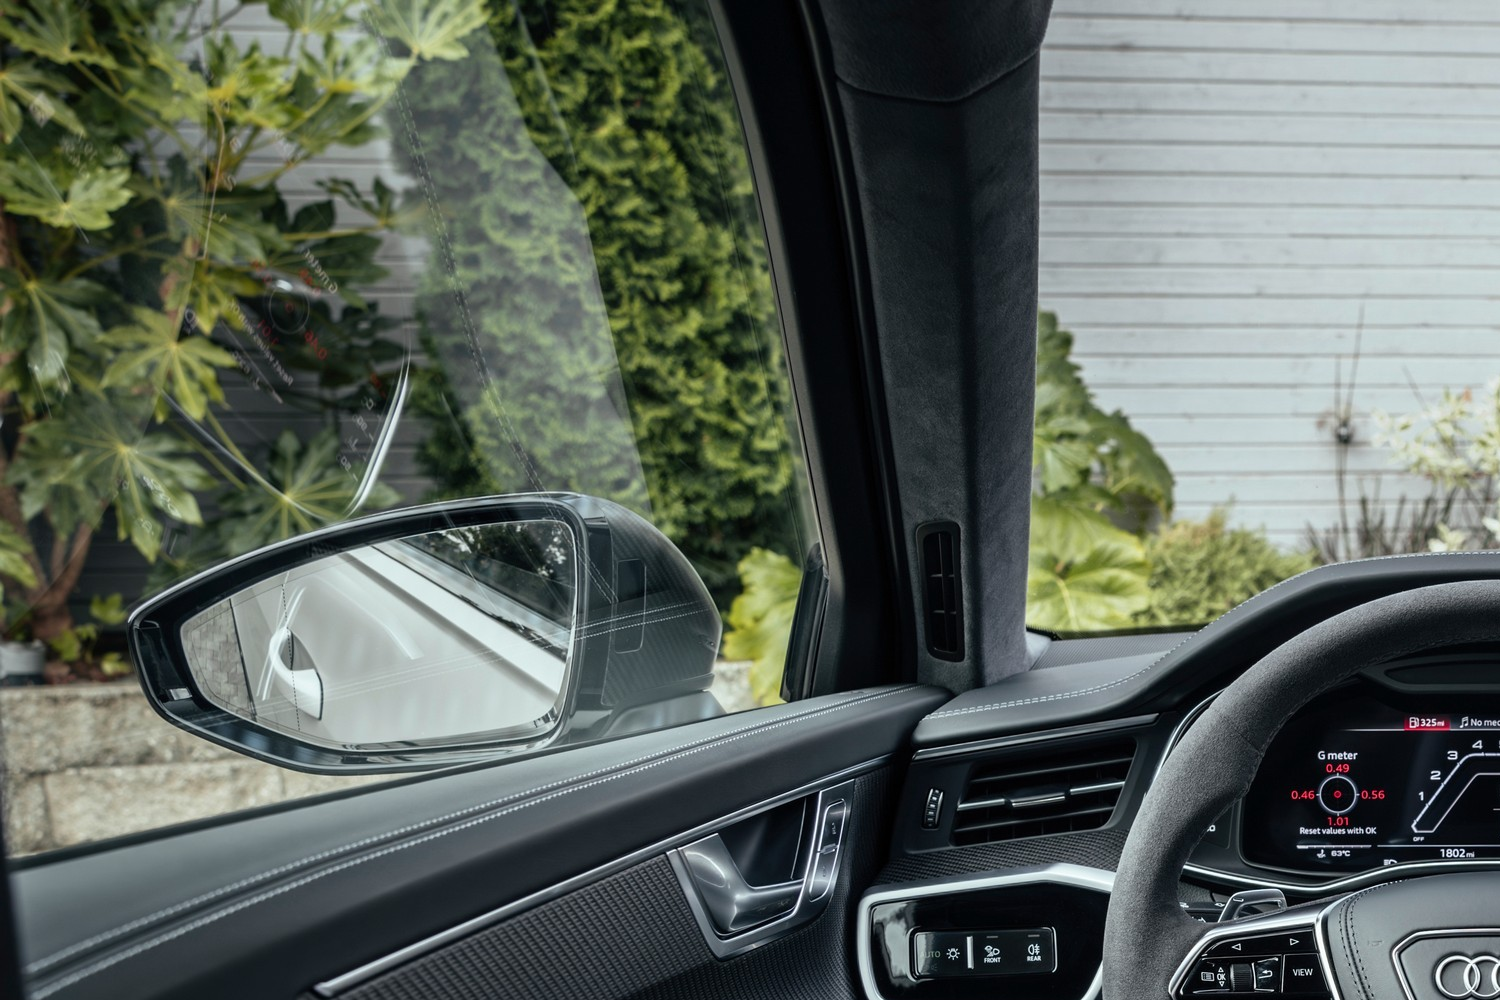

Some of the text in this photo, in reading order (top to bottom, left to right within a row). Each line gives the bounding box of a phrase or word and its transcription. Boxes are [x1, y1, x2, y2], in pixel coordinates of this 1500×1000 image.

[1471, 717, 1482, 726] No
[1472, 740, 1482, 749] 4
[1318, 751, 1358, 760] G meter
[1447, 751, 1458, 760] 3
[1326, 763, 1350, 773] 0.49
[1430, 770, 1441, 780] 2
[1291, 790, 1315, 800] 0.46
[1361, 790, 1385, 800] 0.56
[1418, 791, 1424, 801] 1
[1327, 817, 1349, 826] 1.01
[1300, 827, 1377, 835] Reset values with OK
[1293, 968, 1313, 976] VIEW
[1217, 973, 1226, 981] OK
